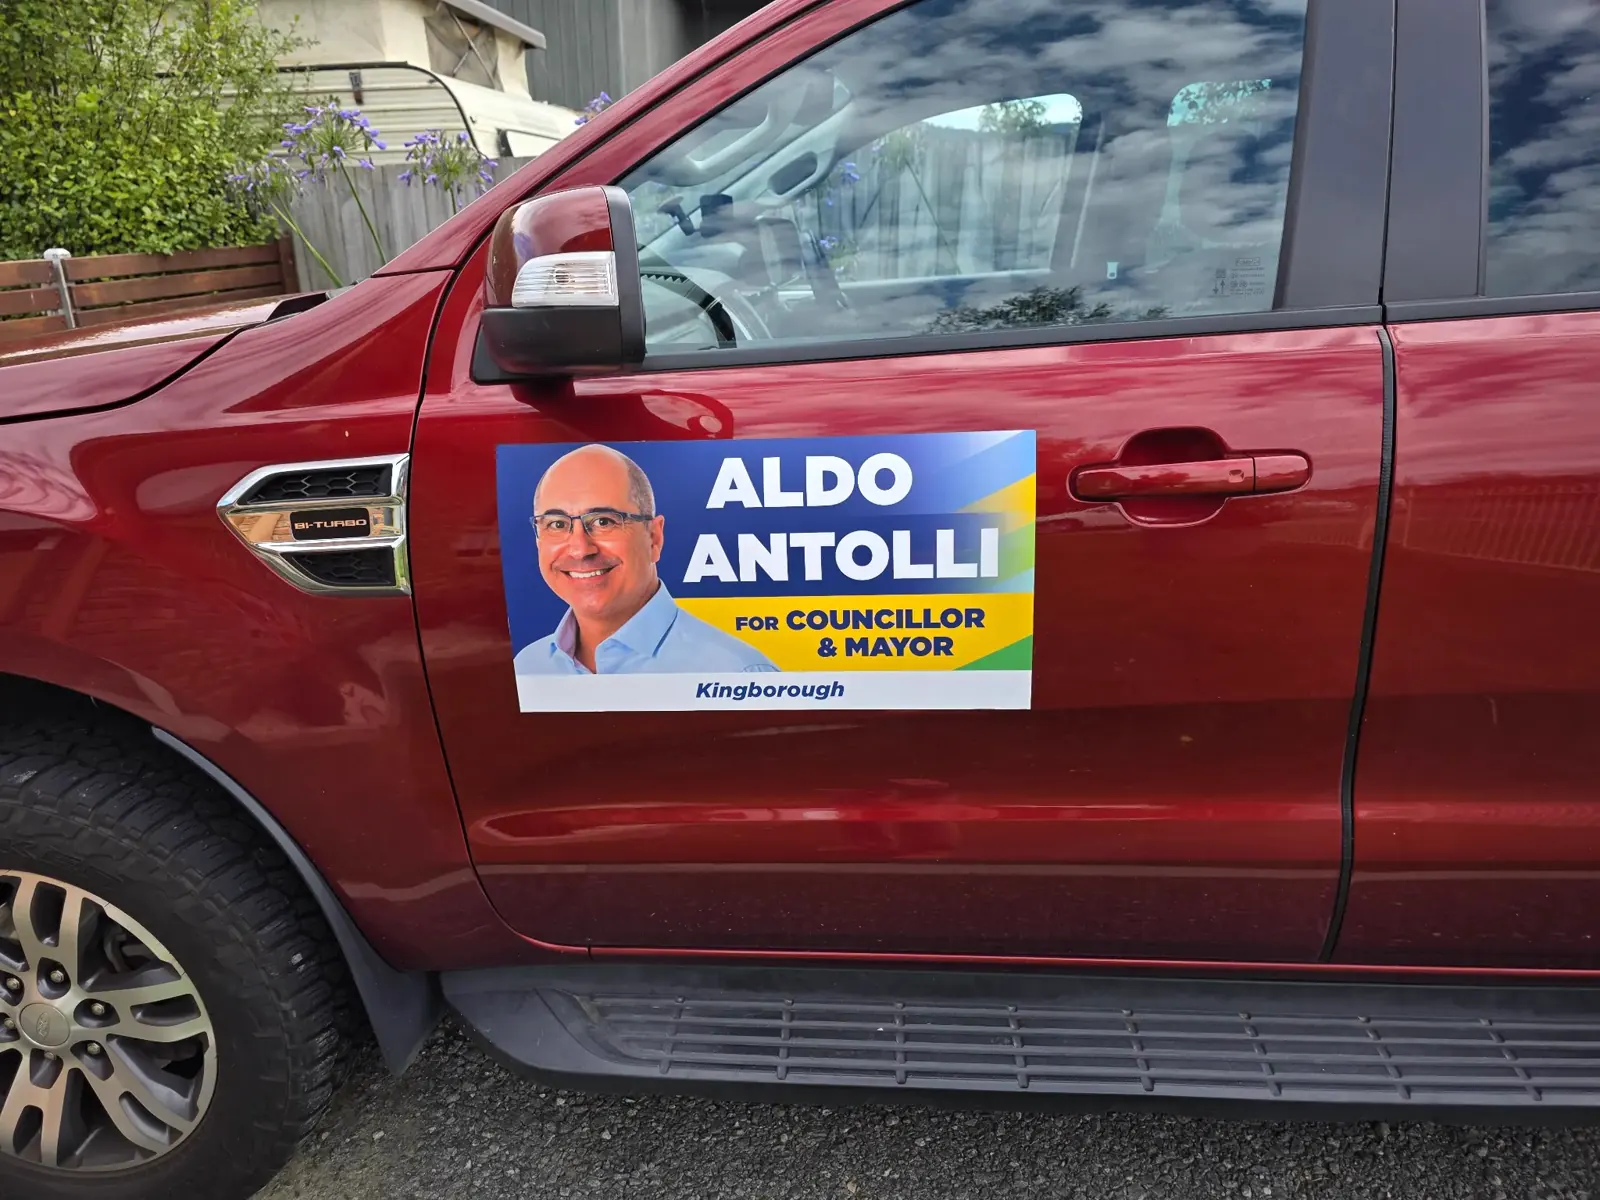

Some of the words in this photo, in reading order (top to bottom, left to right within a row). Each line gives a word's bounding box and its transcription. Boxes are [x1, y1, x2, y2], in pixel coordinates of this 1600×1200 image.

[706, 452, 912, 509] ALDO
[294, 519, 367, 530] BI-TURBO
[683, 527, 999, 583] ANTOLLI
[735, 616, 779, 631] FOR
[786, 608, 985, 630] COUNCILLOR
[817, 637, 837, 657] &
[845, 636, 953, 656] MAYOR
[696, 681, 845, 700] Kingborough
